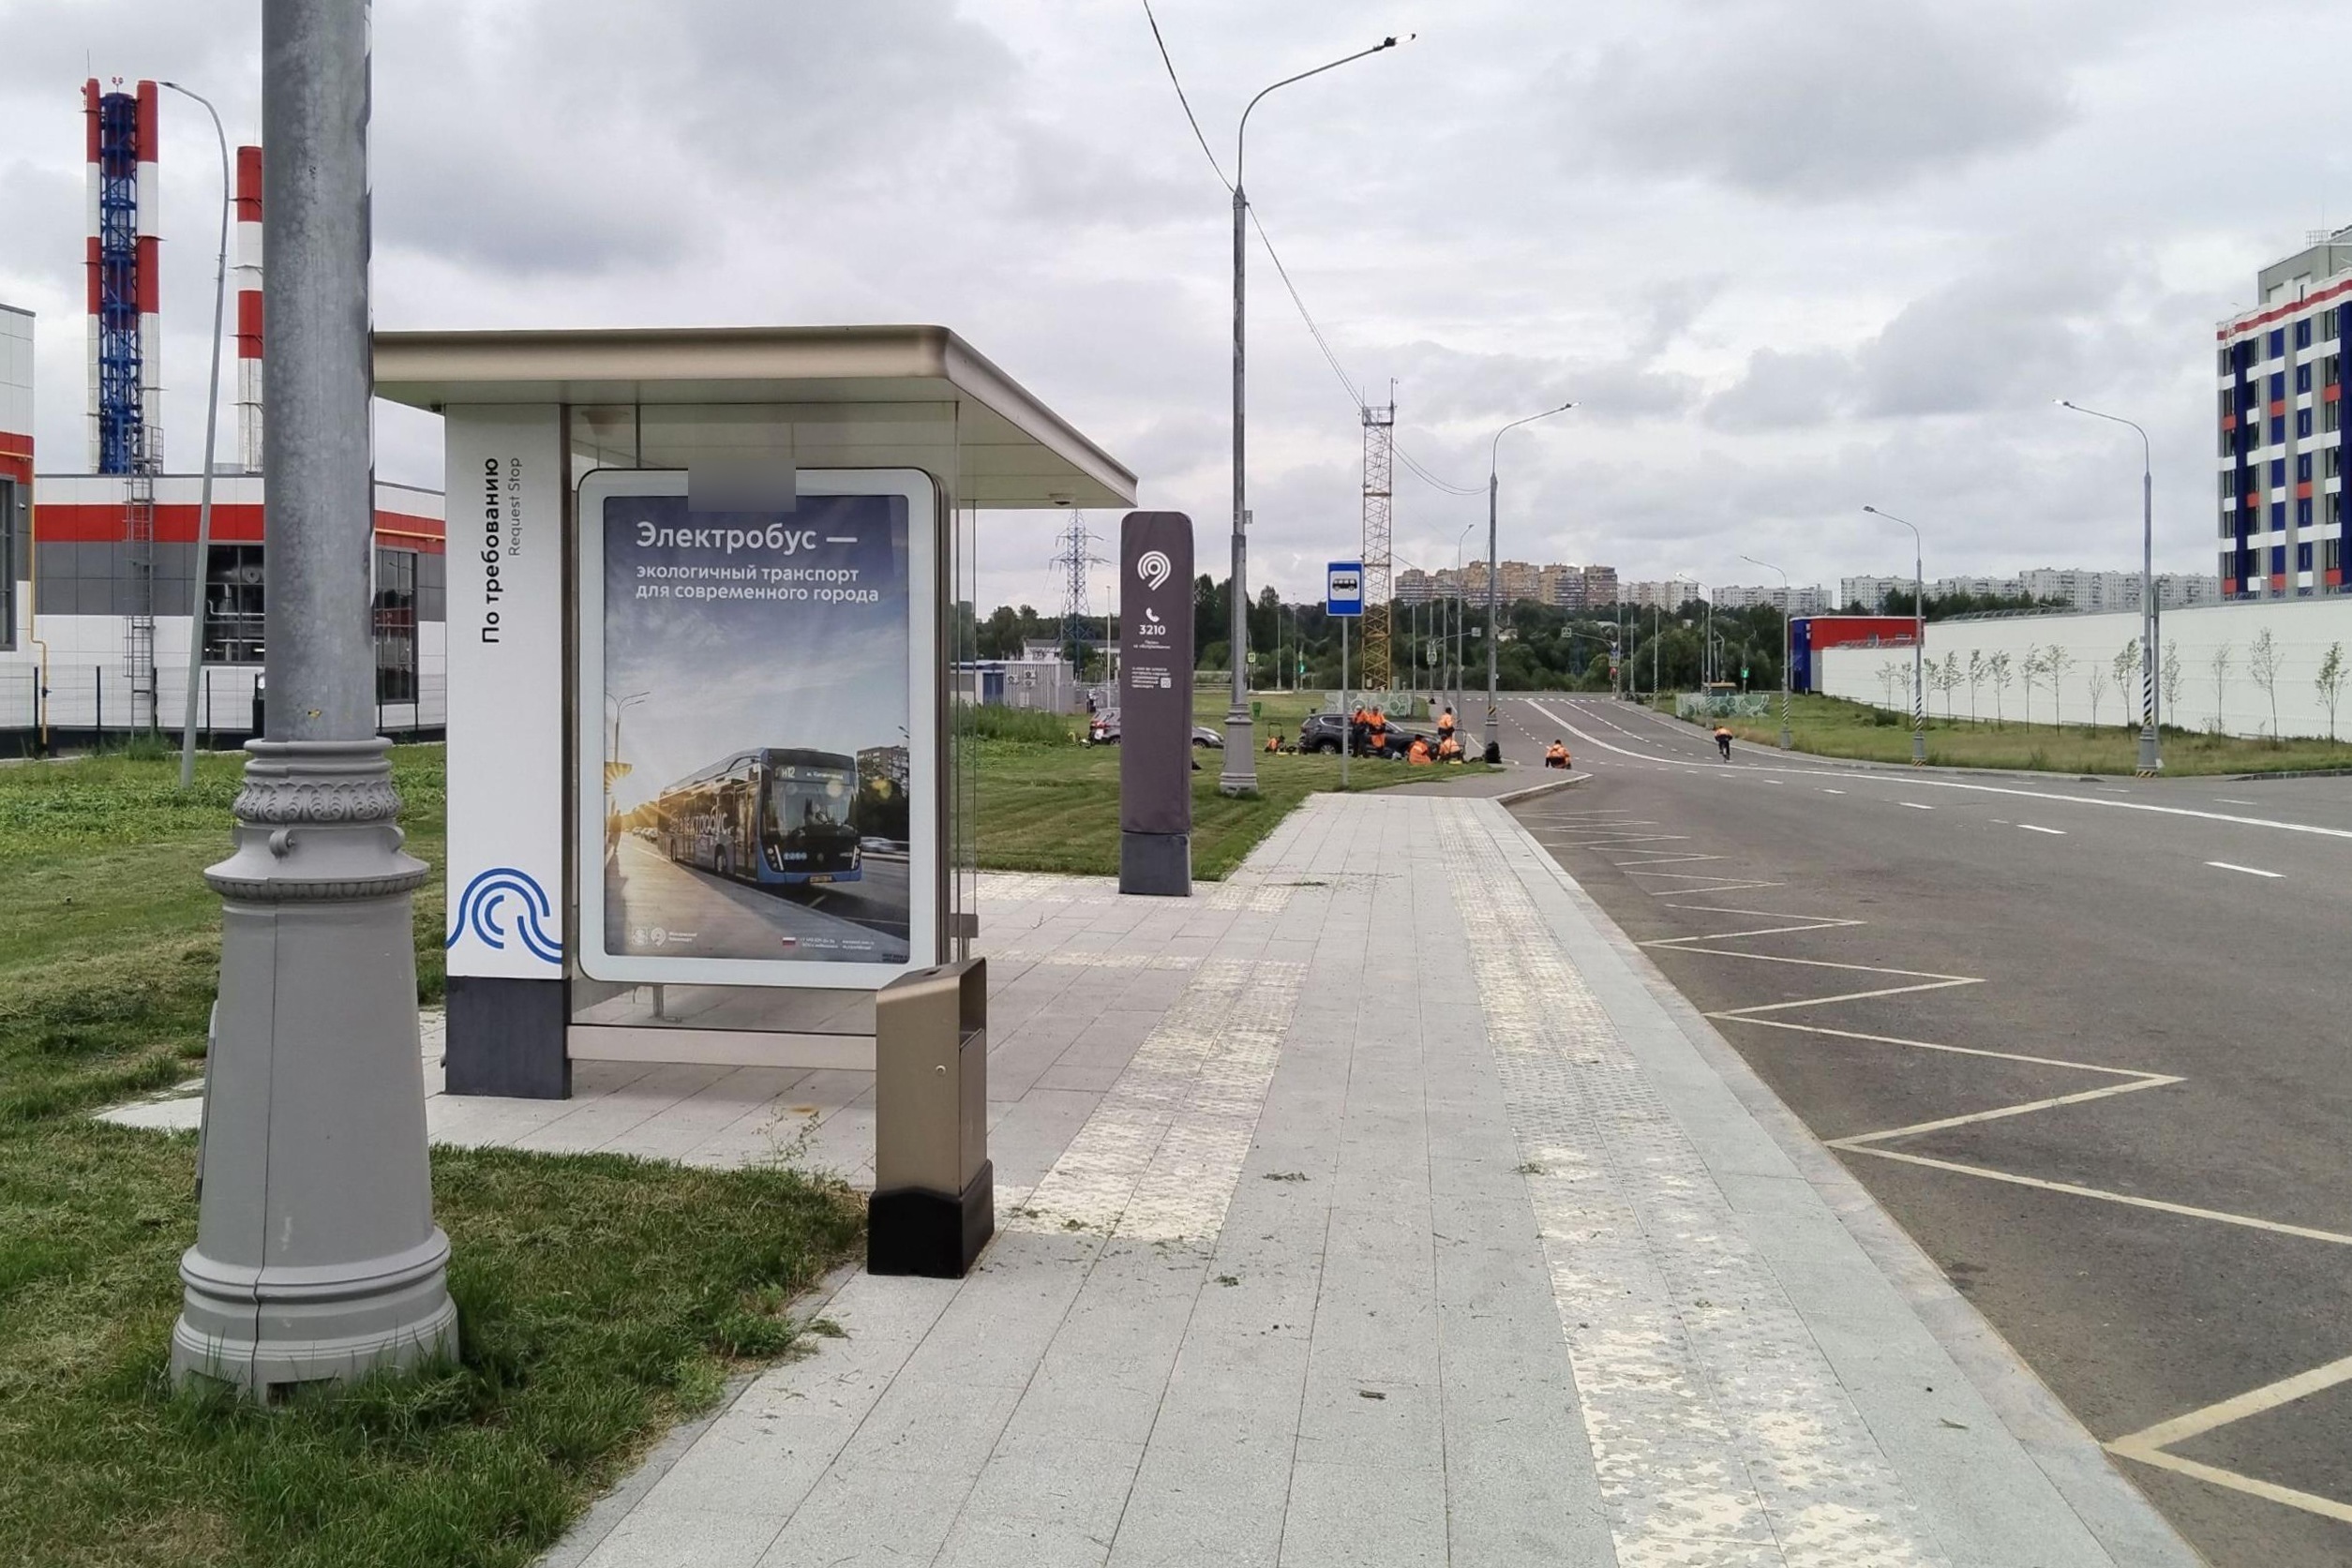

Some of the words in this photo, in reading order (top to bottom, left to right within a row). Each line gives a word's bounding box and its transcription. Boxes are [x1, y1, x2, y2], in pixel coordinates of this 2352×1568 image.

[508, 457, 523, 491] Stop
[480, 457, 503, 605] требованию
[508, 495, 523, 556] Request
[636, 521, 816, 556] Электробус
[636, 564, 757, 580] экологичный
[761, 567, 859, 584] транспорт
[636, 585, 669, 600] для
[674, 586, 808, 602] современного
[814, 590, 879, 605] города
[482, 611, 500, 643] По
[1139, 624, 1166, 635] 3210
